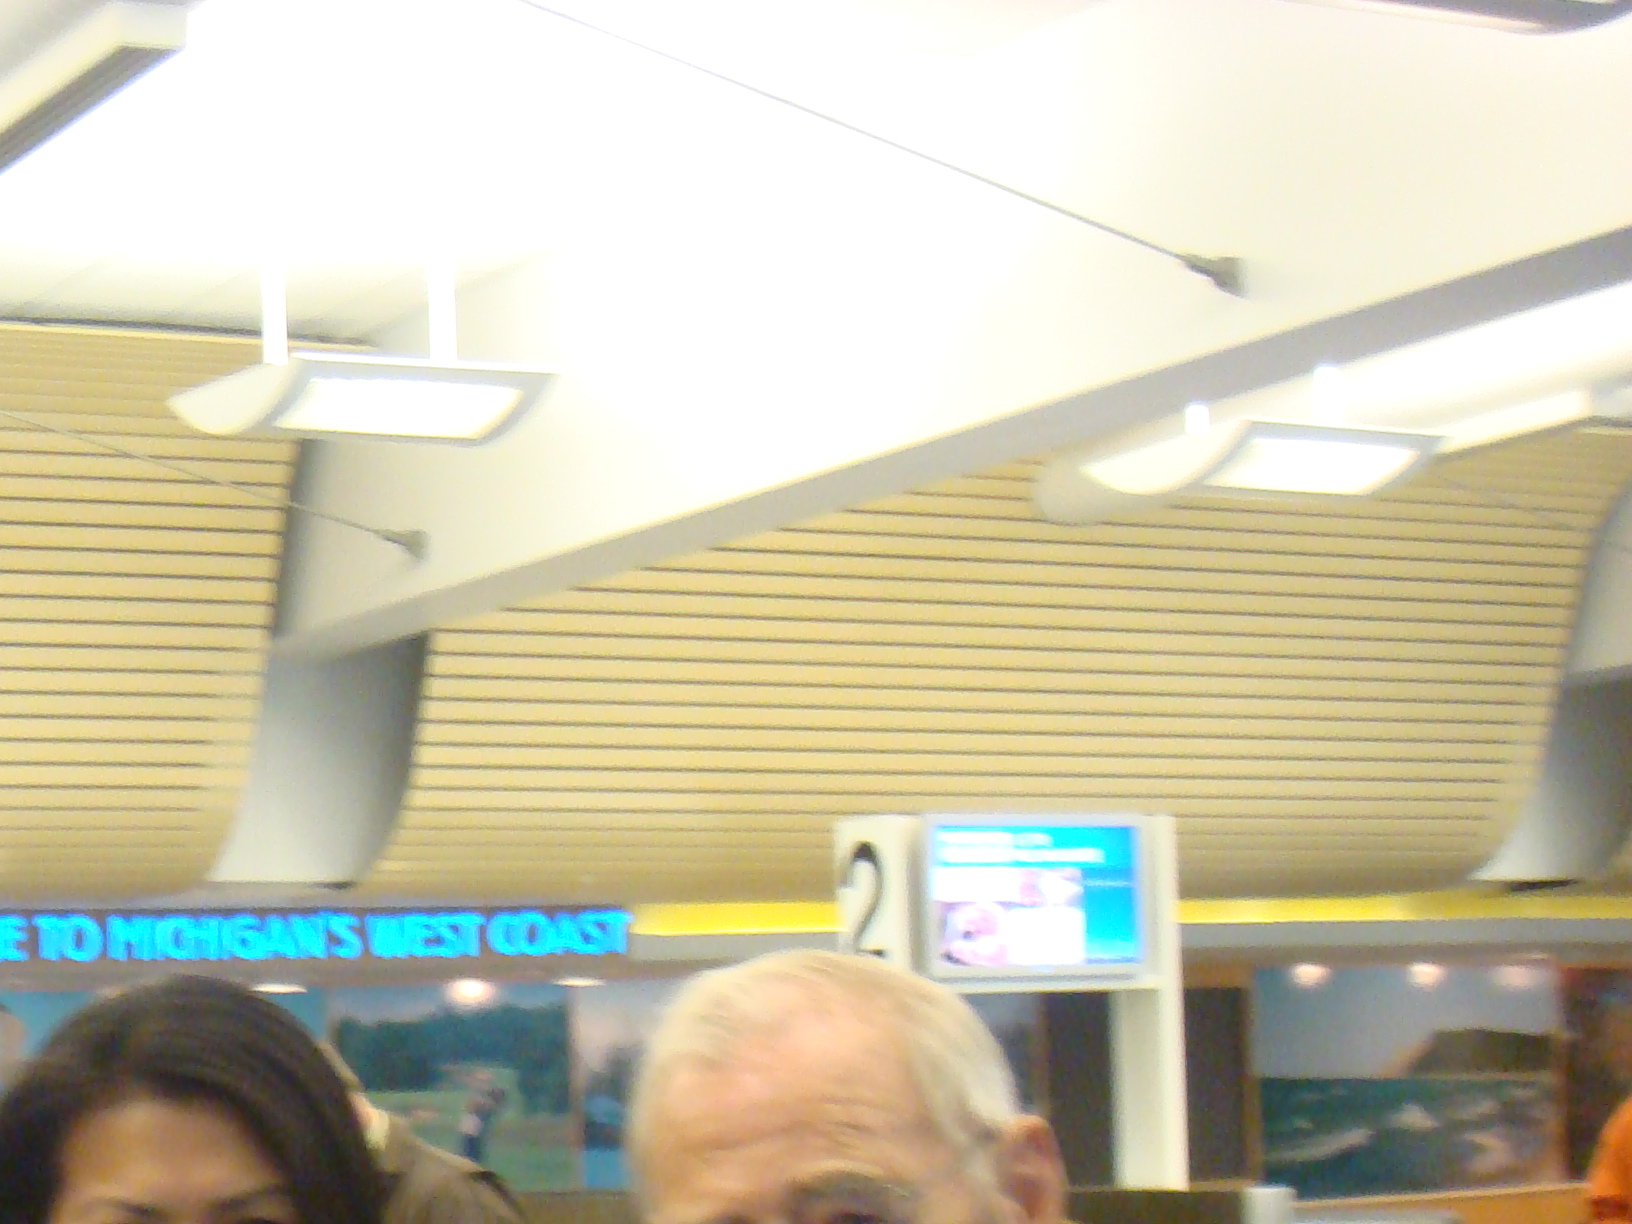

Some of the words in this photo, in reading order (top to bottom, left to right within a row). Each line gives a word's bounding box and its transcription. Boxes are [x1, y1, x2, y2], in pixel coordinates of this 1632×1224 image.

[32, 914, 104, 962] TO
[105, 911, 364, 961] MICHIGAN'S
[367, 911, 485, 958] WEST
[486, 909, 633, 956] COAST
[837, 840, 888, 957] 2
